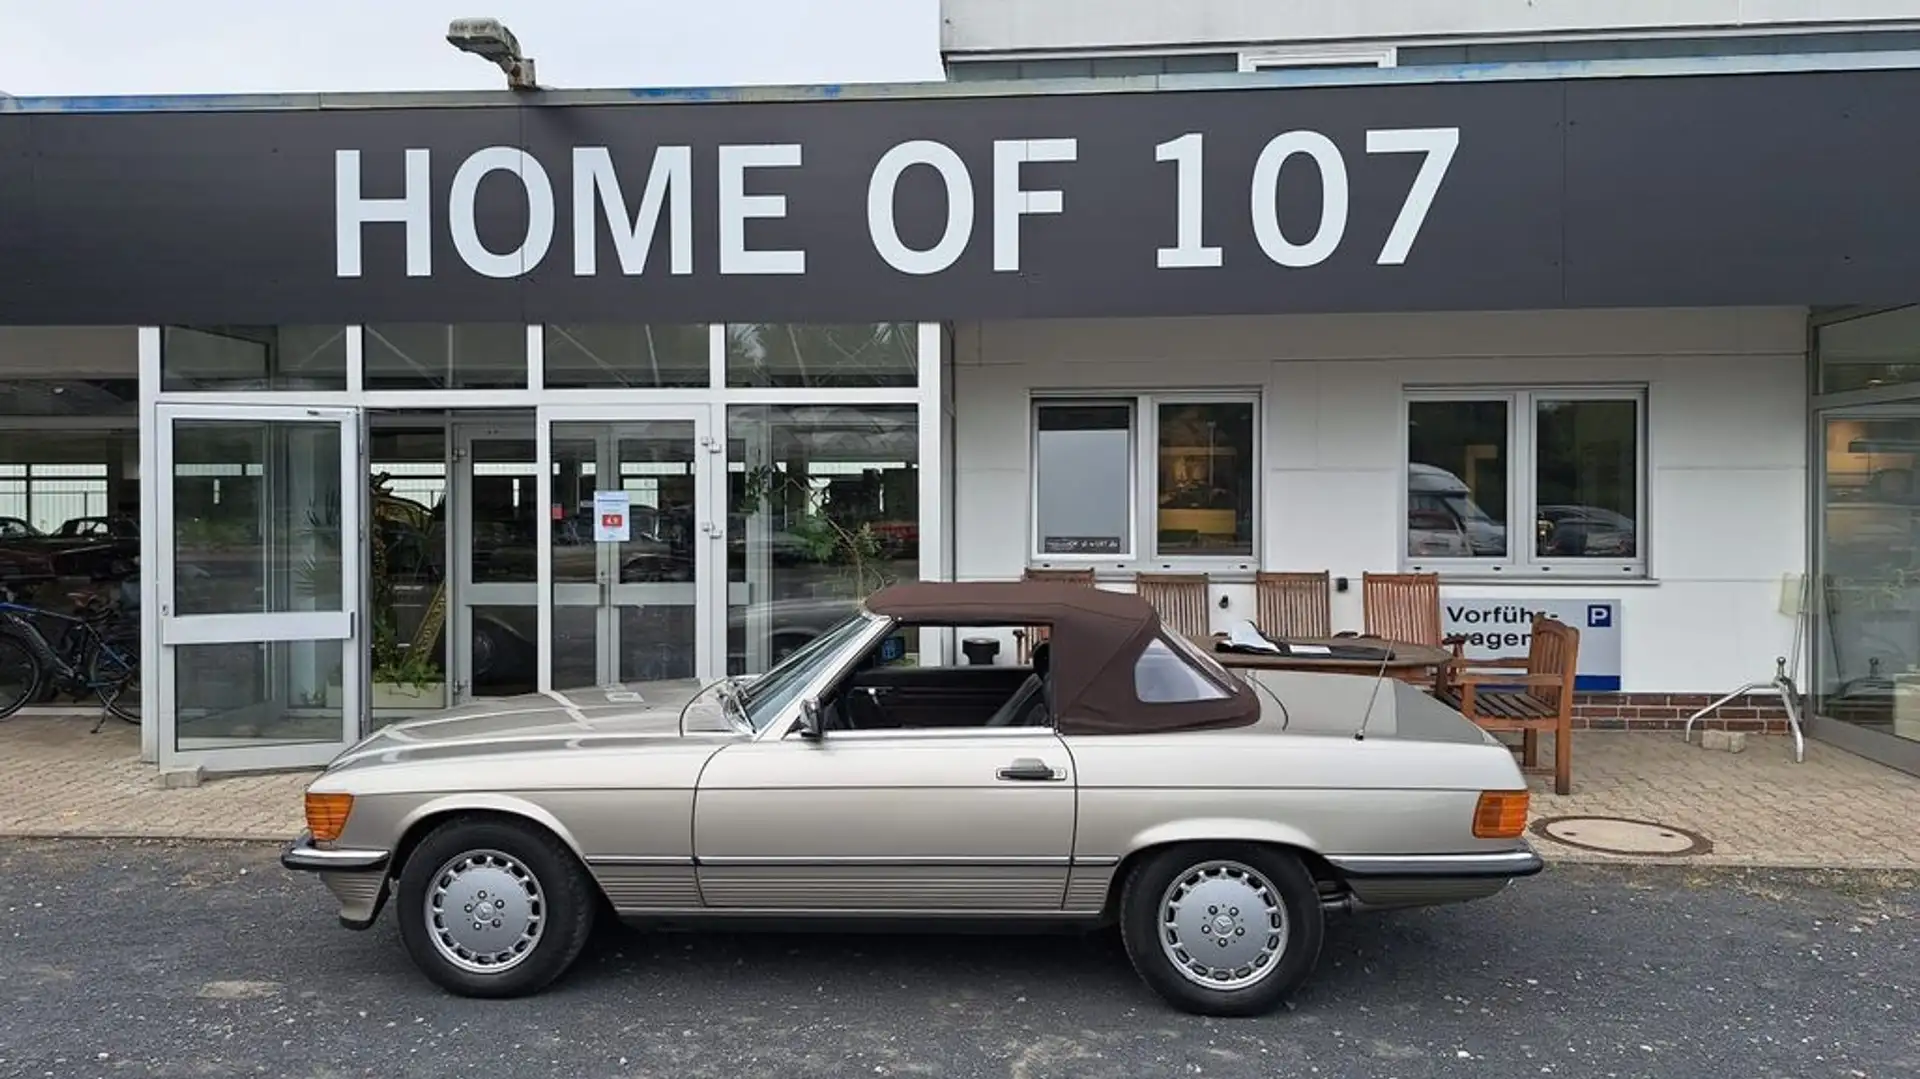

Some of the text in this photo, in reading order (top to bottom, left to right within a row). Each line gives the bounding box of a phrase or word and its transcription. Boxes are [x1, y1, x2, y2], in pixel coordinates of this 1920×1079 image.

[335, 127, 1460, 278] HOME OF 107
[1590, 608, 1609, 625] P
